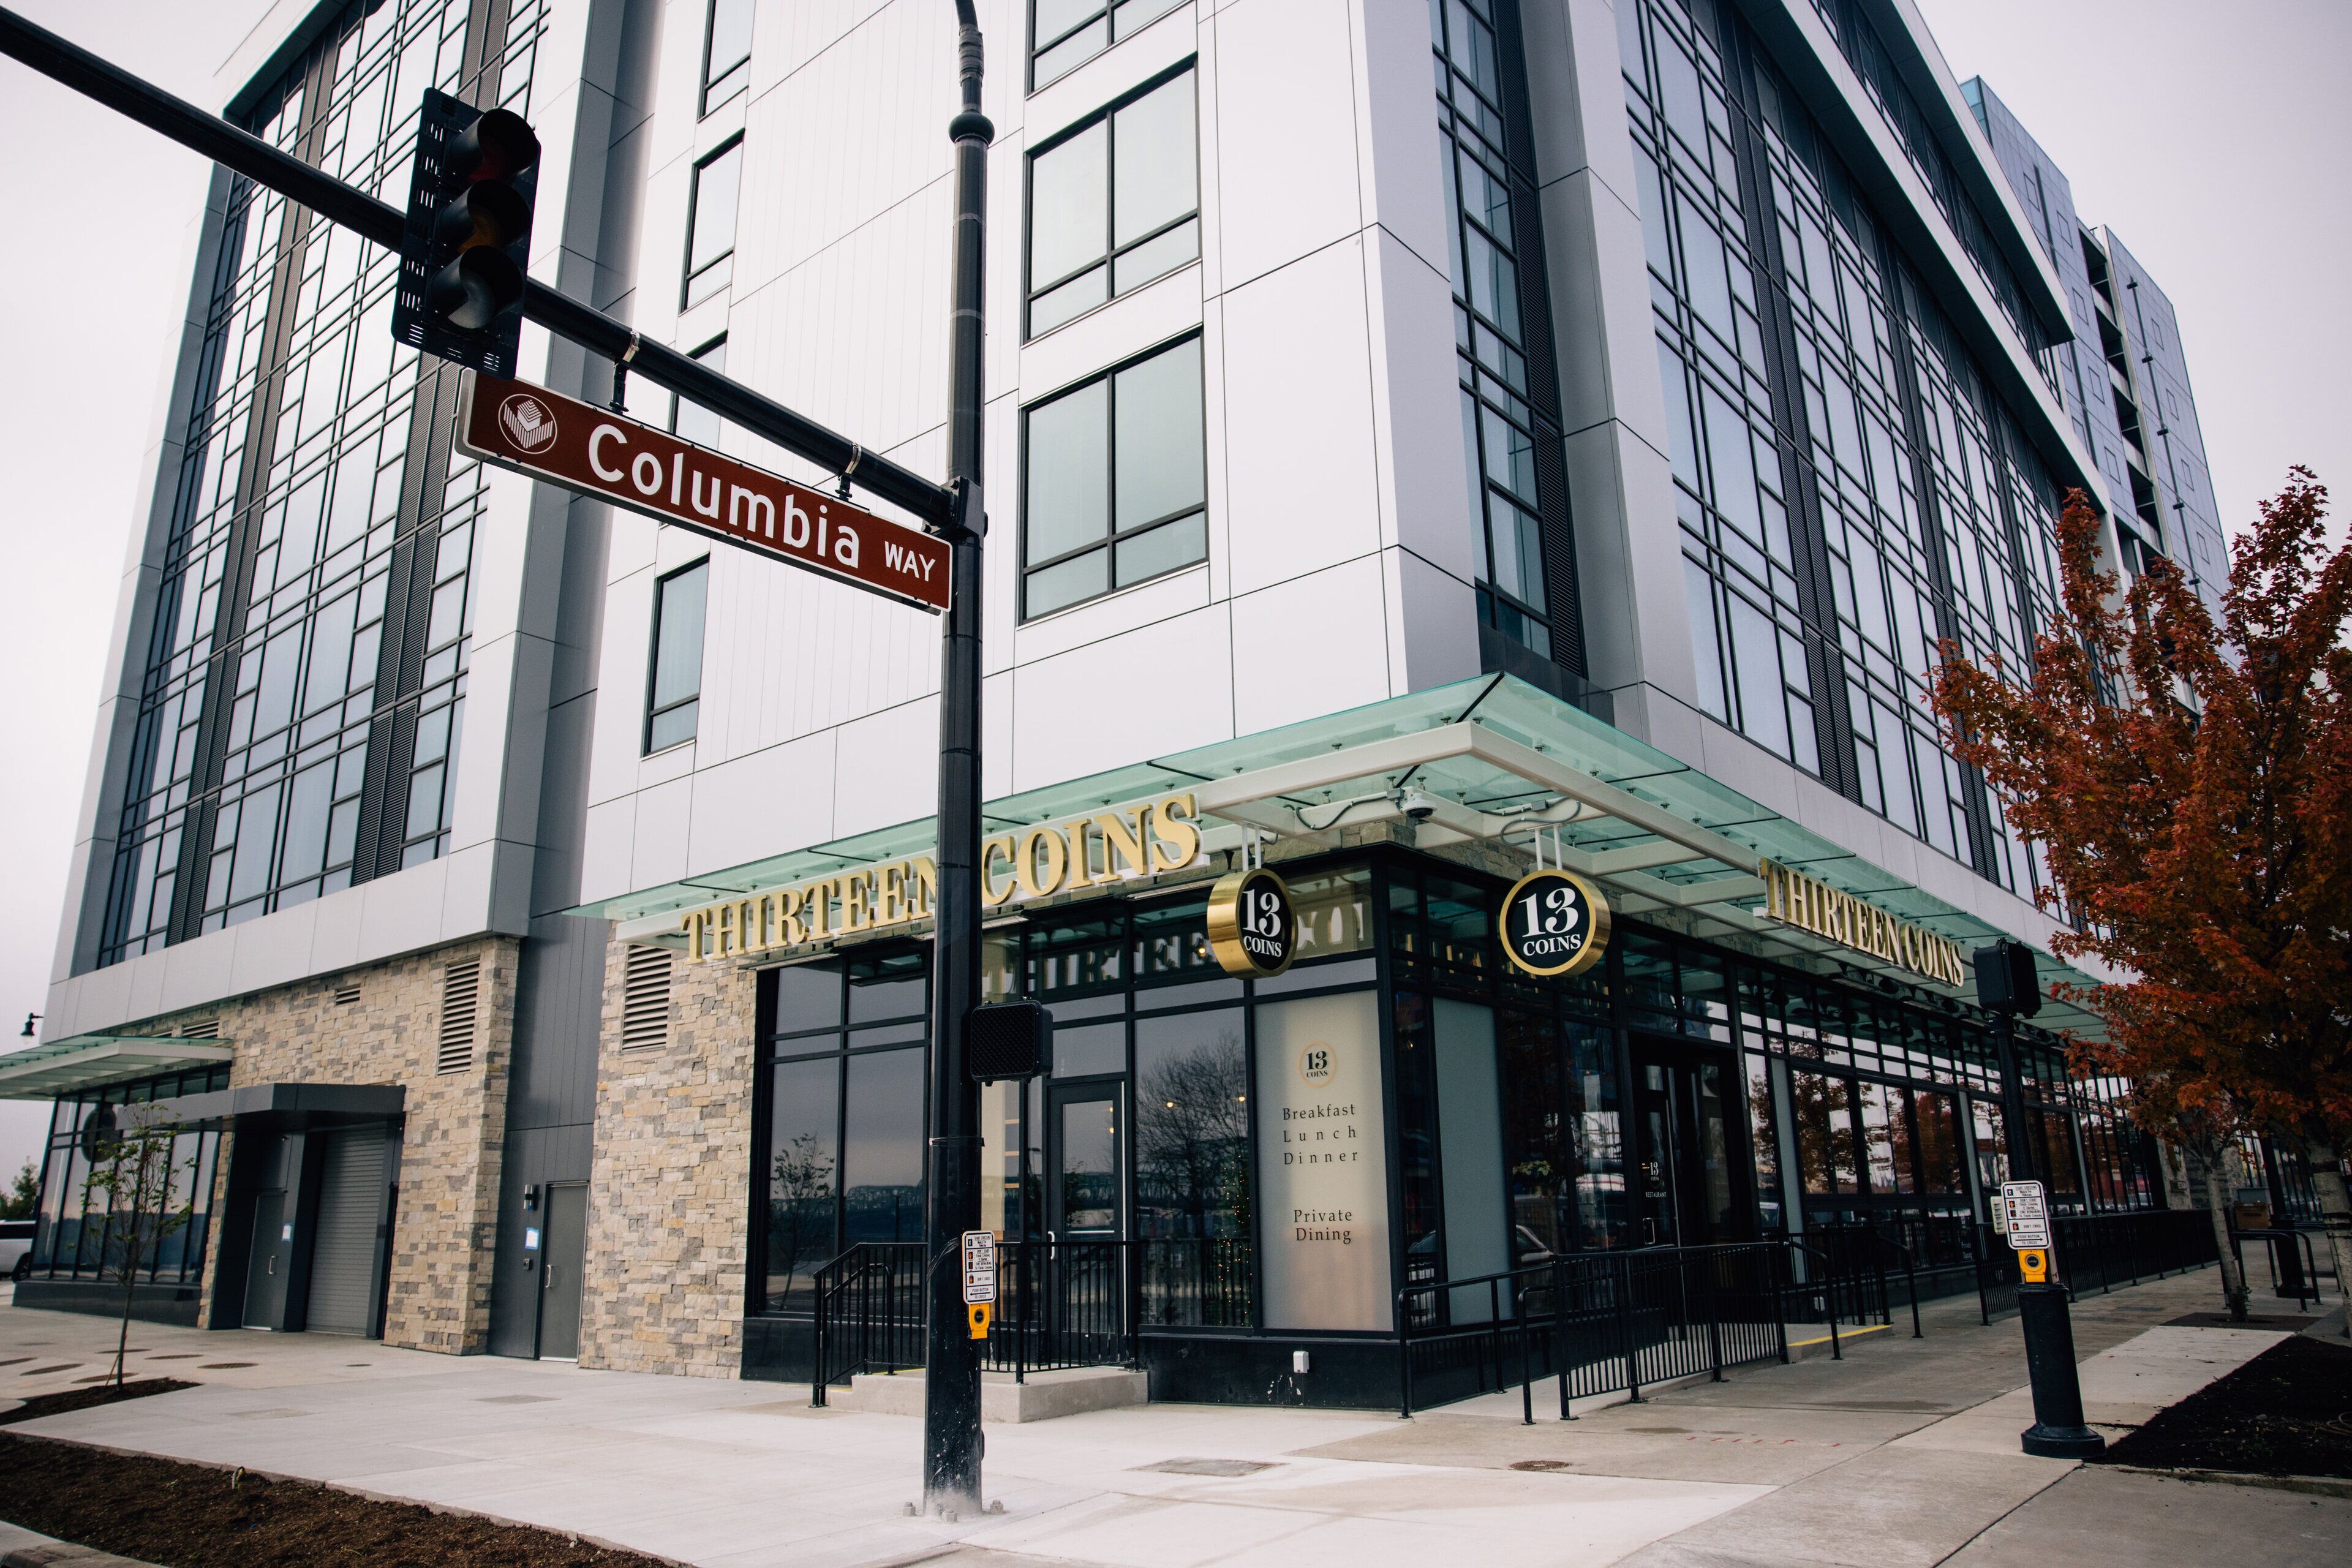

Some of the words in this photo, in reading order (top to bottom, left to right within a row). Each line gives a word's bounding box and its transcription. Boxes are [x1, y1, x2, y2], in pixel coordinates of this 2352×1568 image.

[589, 423, 859, 568] Columbia
[884, 541, 937, 582] WAY
[981, 793, 1202, 905] COINS
[1242, 888, 1281, 937] 13
[1517, 886, 1580, 938] 13
[1757, 857, 1901, 965] THIRTEEN
[1900, 920, 1964, 987] COINS
[1243, 935, 1281, 958] COINS
[1522, 933, 1581, 957] COINS
[1306, 1050, 1328, 1070] 13
[1306, 1069, 1328, 1078] COINS
[1283, 1104, 1355, 1121] Breakfast
[1283, 1126, 1357, 1143] Lunch
[1283, 1150, 1358, 1165] Dinner
[1649, 1161, 1659, 1176] 13
[1294, 1209, 1352, 1223] Private
[1296, 1227, 1351, 1245] Dining
